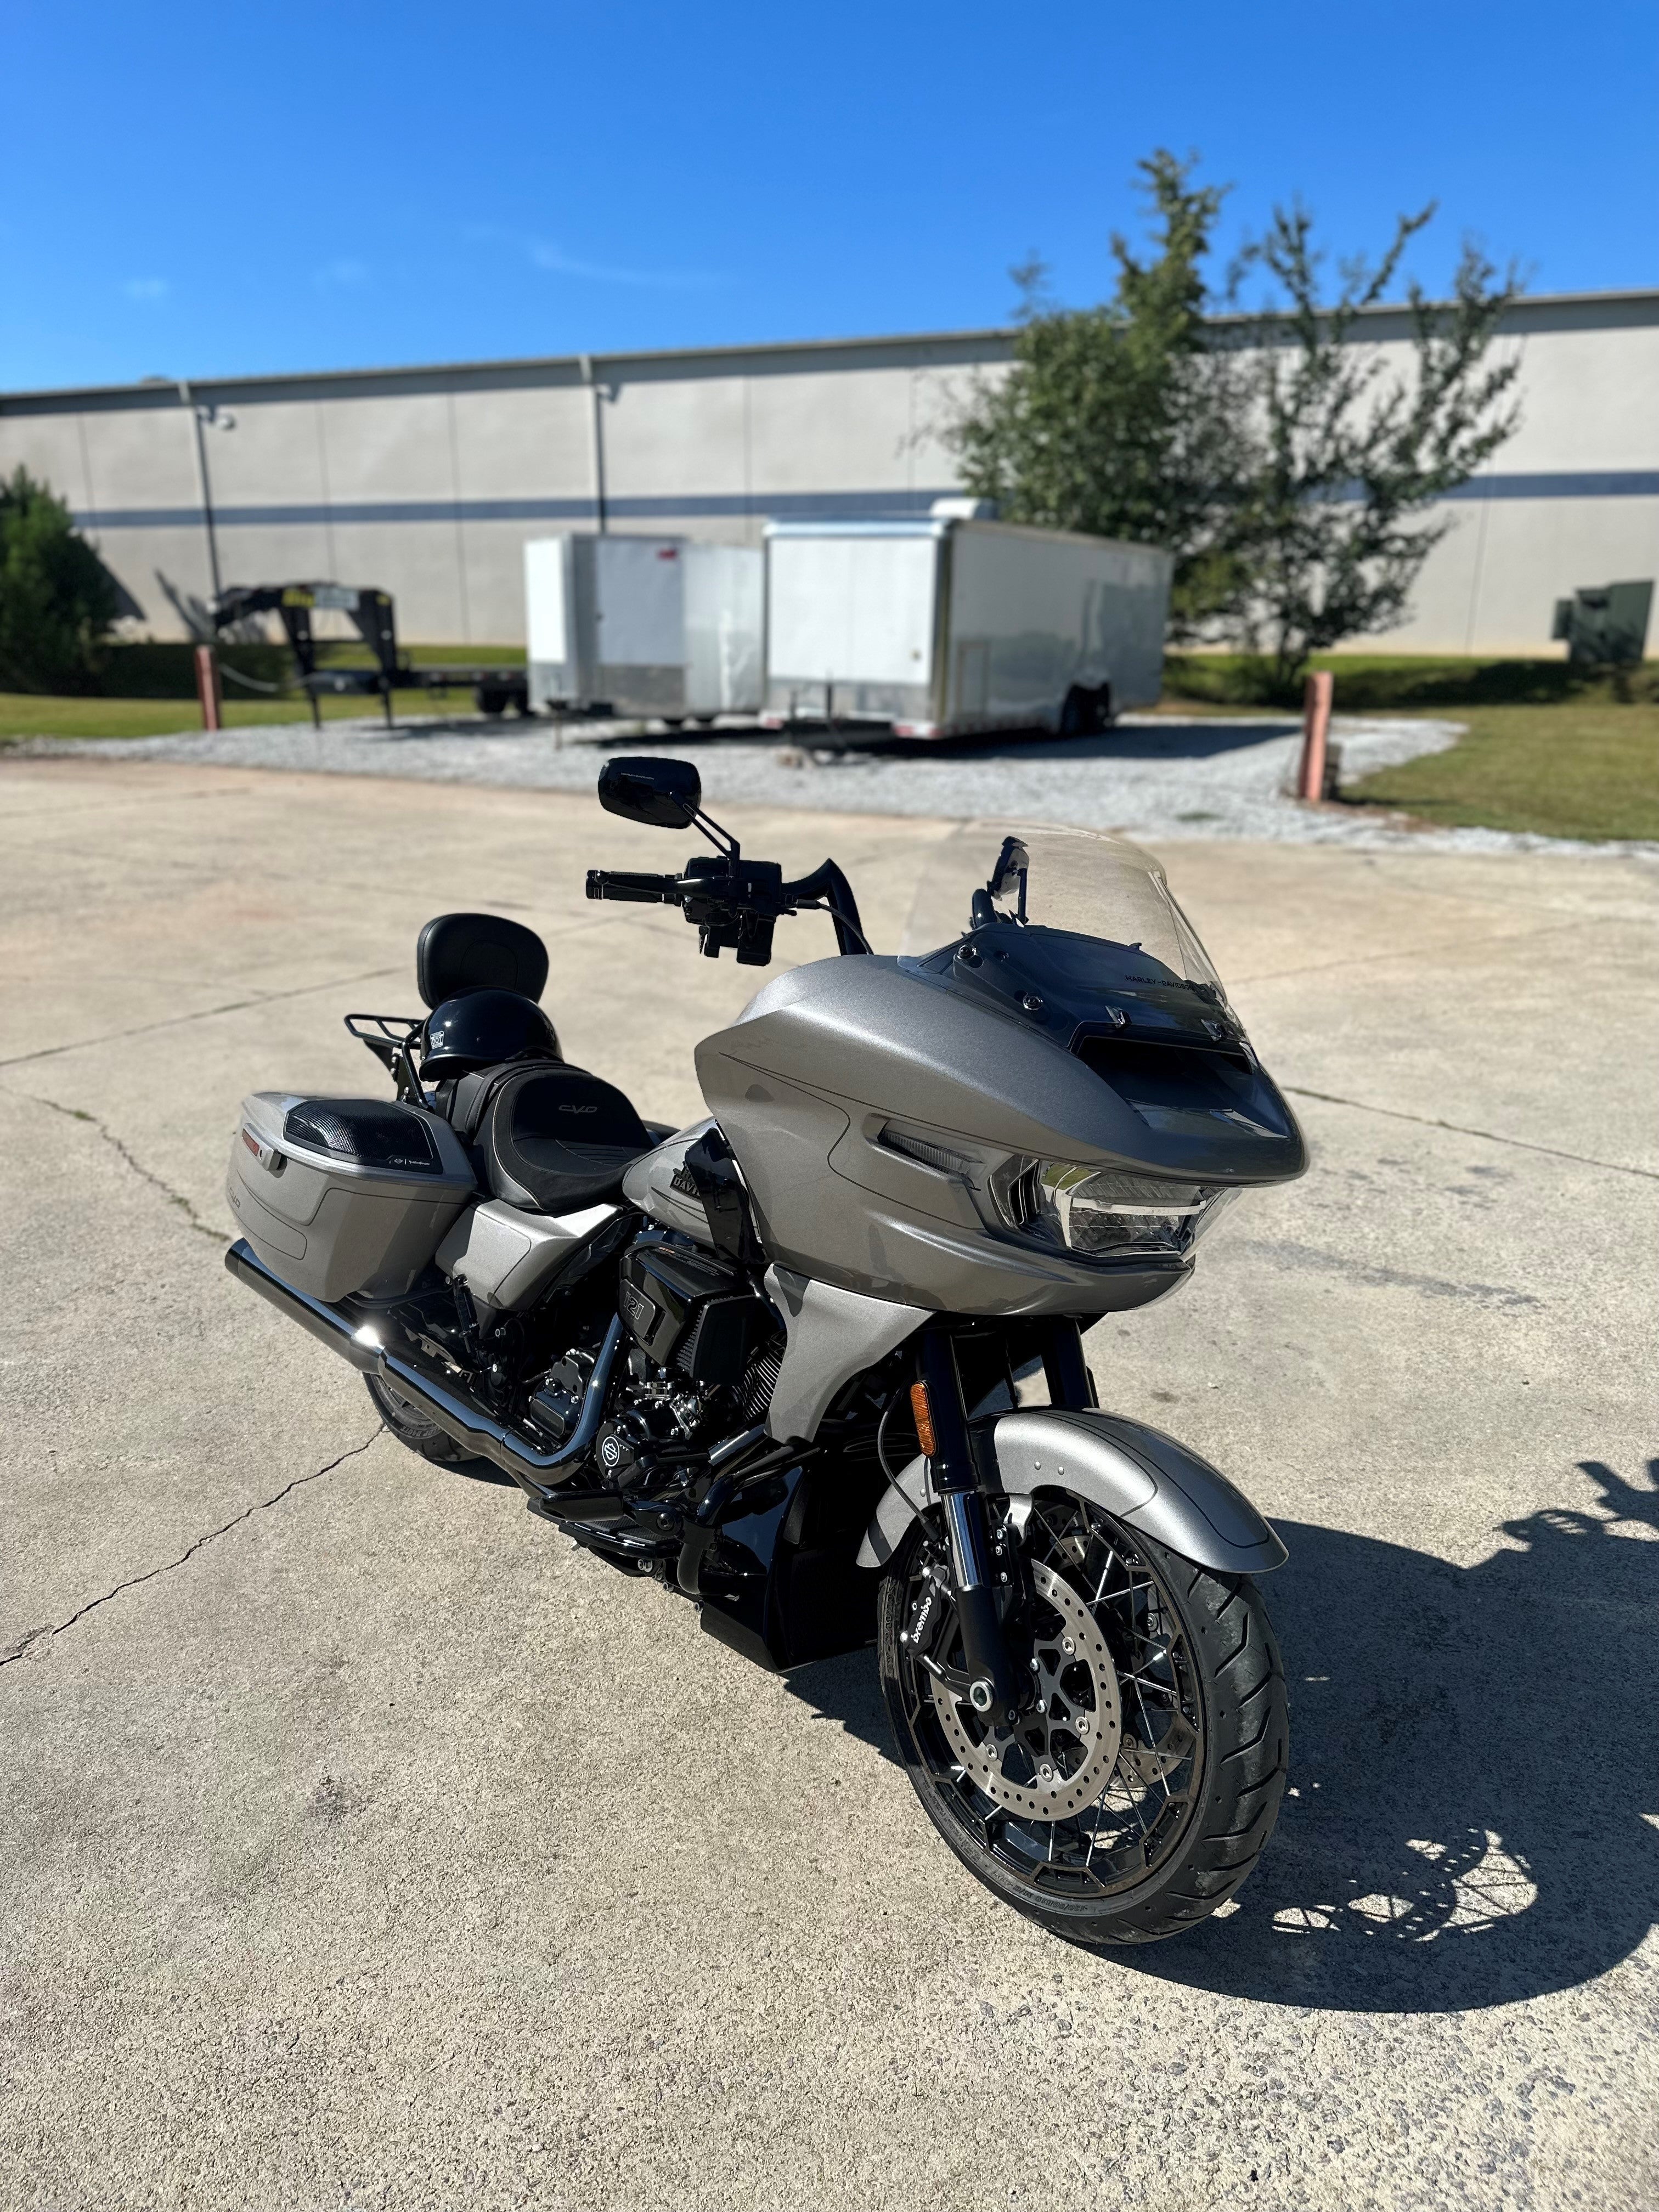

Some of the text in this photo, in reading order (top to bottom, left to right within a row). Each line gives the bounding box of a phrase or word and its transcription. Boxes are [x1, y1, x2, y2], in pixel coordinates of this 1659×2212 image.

[1125, 974, 1194, 991] HARLEY-DAVIDSO
[431, 1034, 443, 1045] DOT
[558, 1104, 597, 1114] CVO
[624, 1291, 644, 1319] 121
[911, 1597, 932, 1644] brembo
